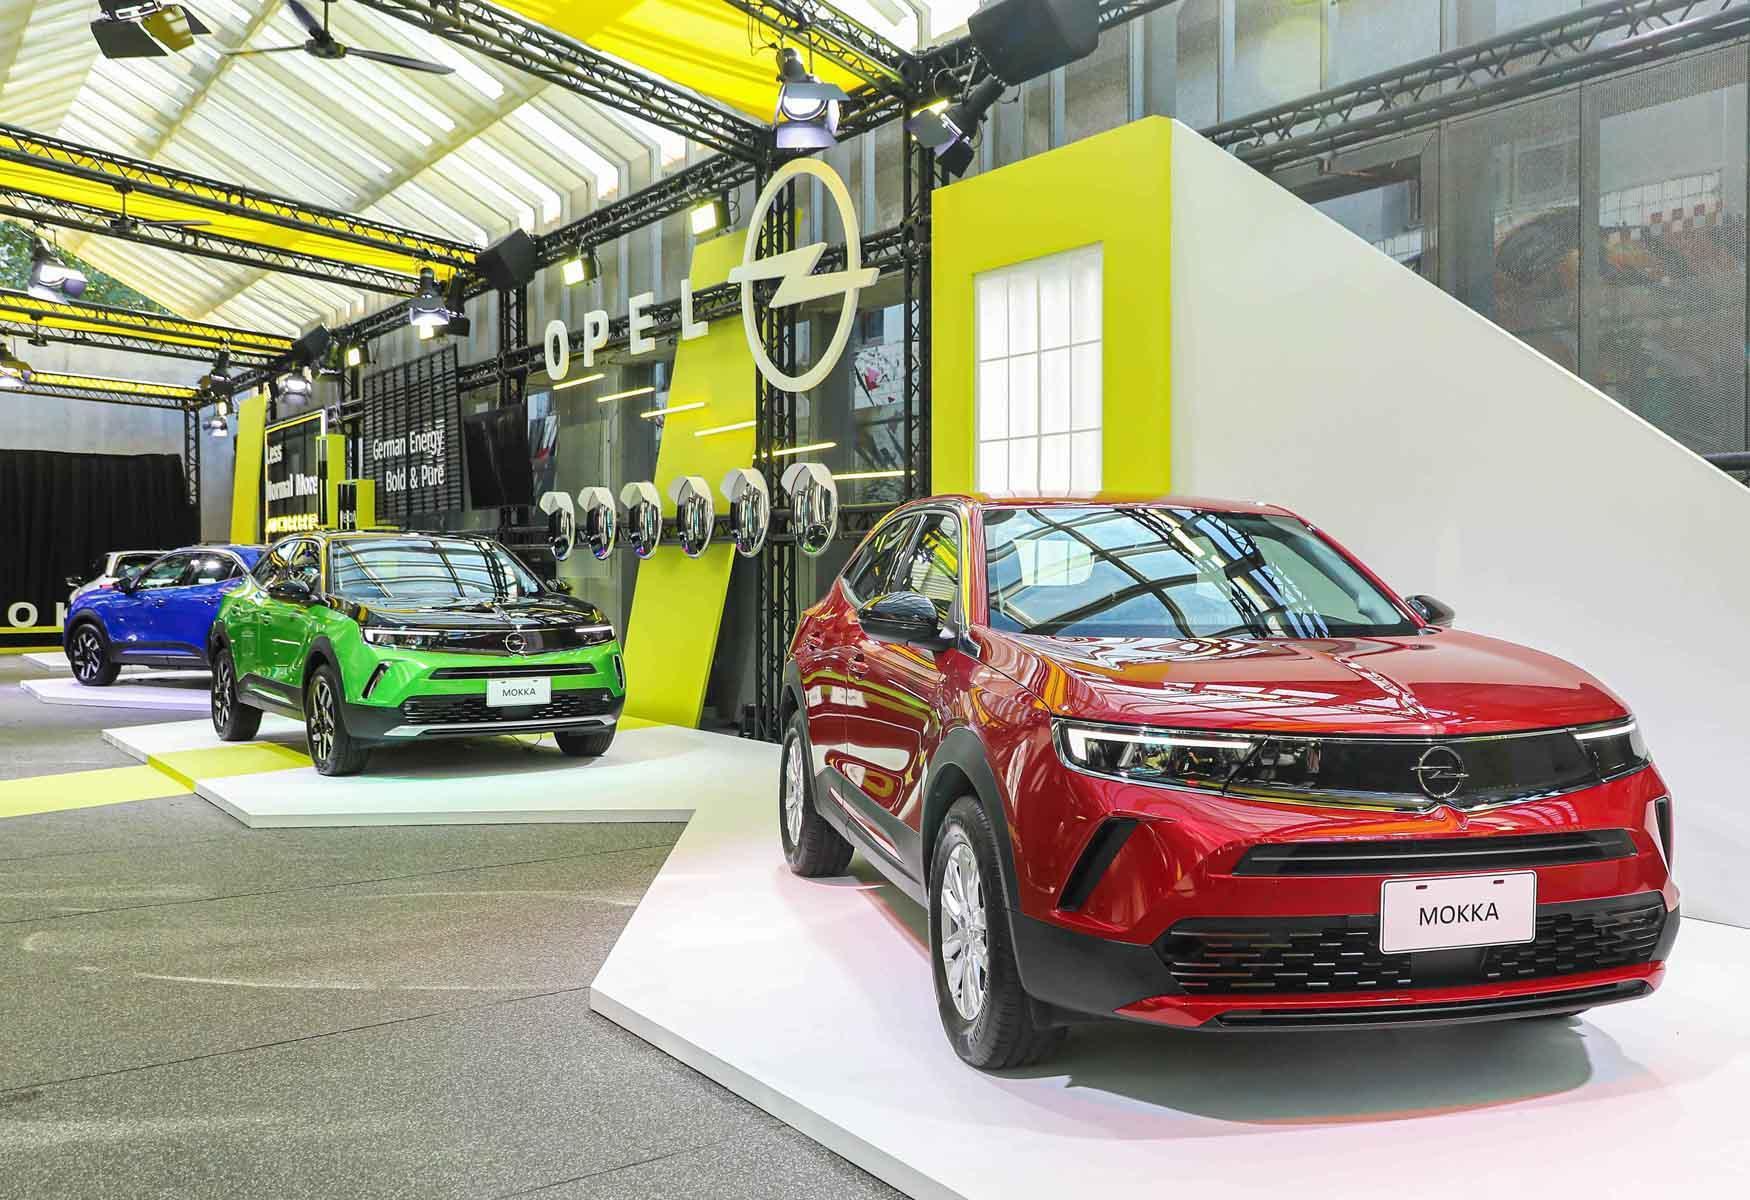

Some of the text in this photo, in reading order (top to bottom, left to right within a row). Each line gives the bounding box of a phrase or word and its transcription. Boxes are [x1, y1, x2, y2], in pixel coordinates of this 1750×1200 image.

[544, 279, 709, 380] OPEL
[373, 430, 445, 460] German Energy
[295, 473, 318, 496] More
[385, 464, 445, 492] Bold & Pure
[502, 687, 536, 697] MOKKA
[1419, 902, 1499, 926] MOKKA
